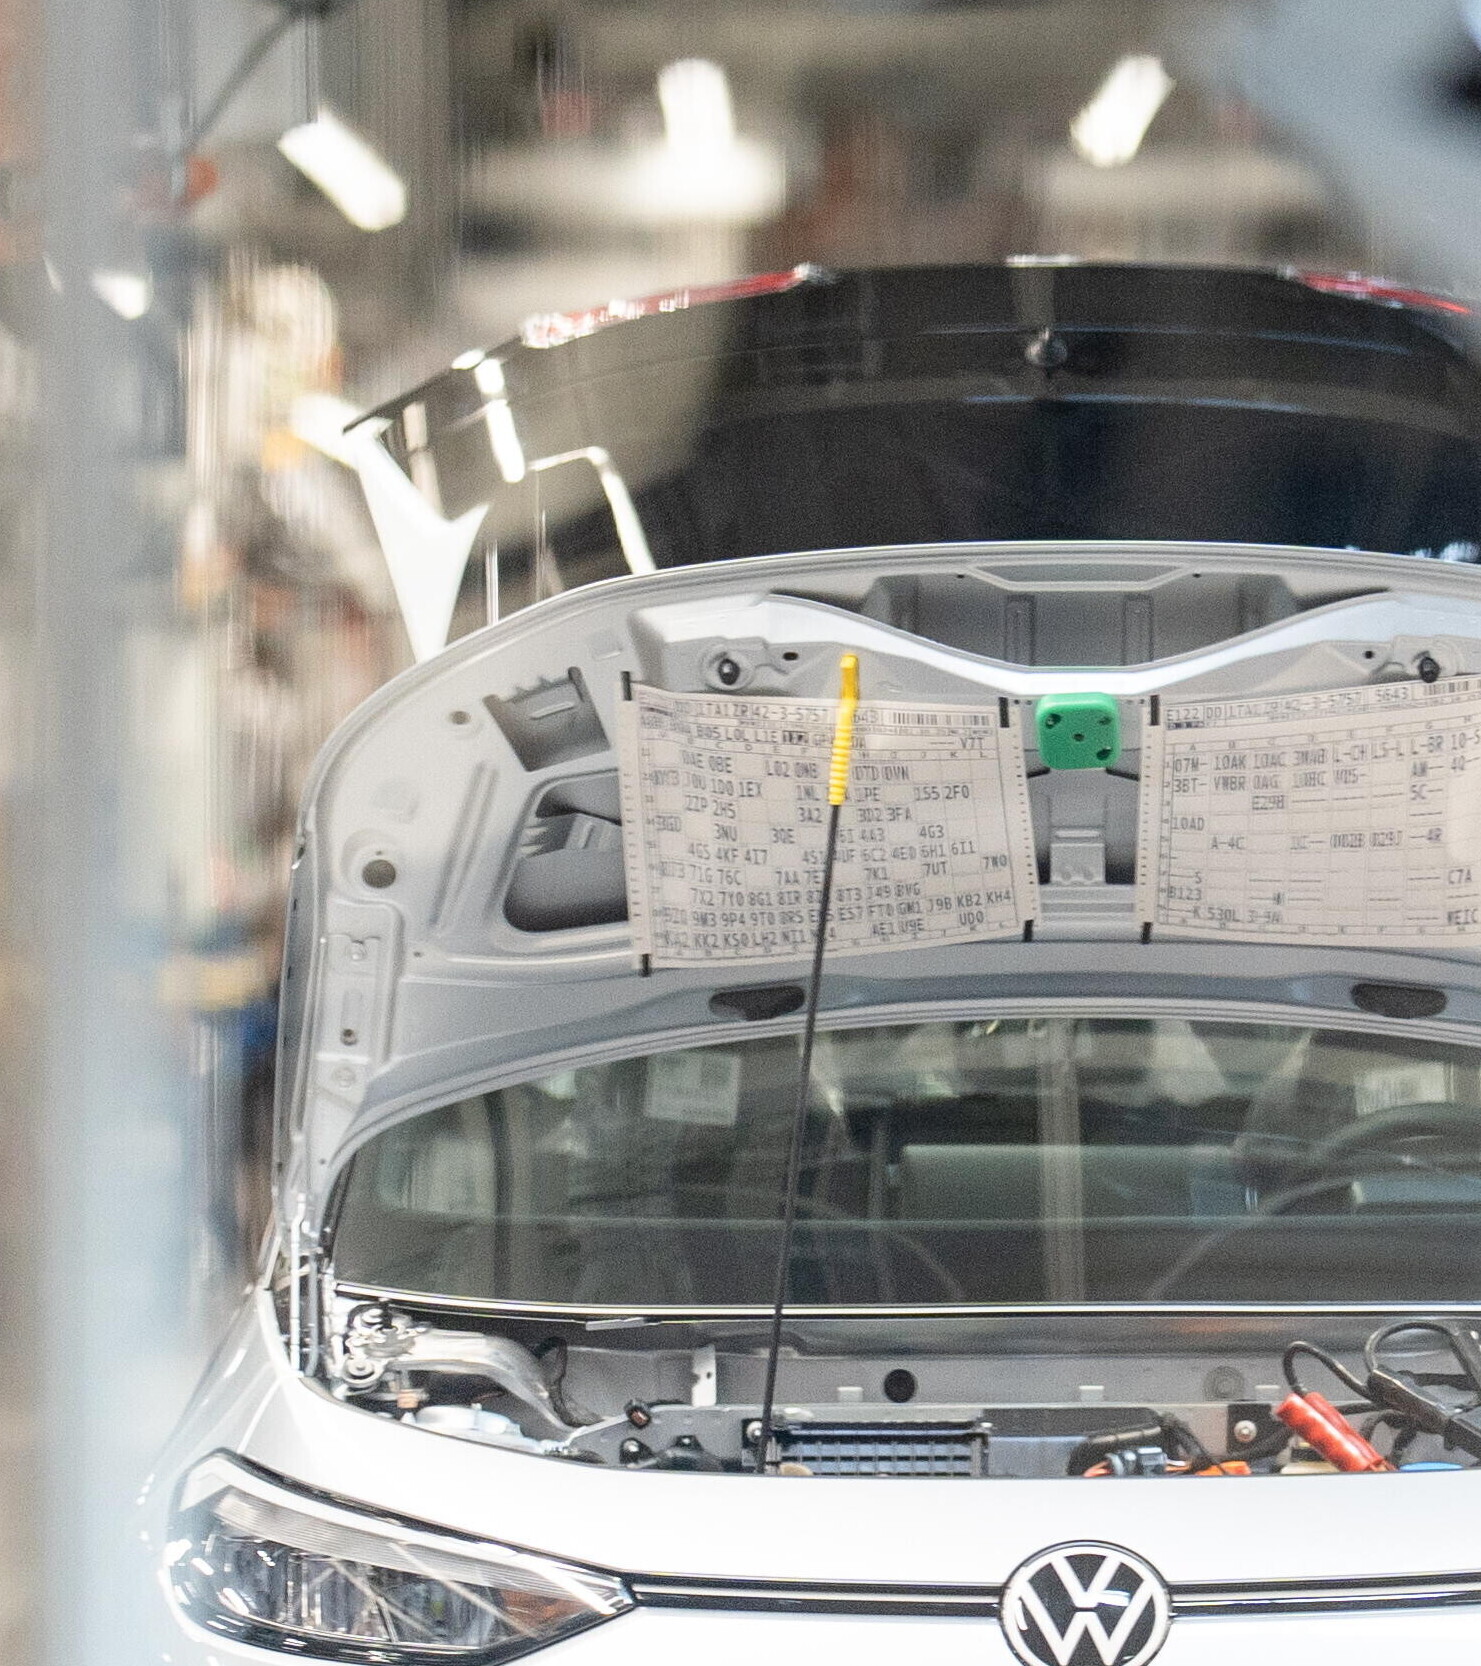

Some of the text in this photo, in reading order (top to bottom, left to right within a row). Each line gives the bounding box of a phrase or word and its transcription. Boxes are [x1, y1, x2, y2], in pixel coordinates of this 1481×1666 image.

[1167, 708, 1200, 722] E122
[1214, 755, 1246, 770] 10AK
[944, 785, 970, 799] 2F0
[1171, 817, 1204, 831] 10AD
[919, 825, 944, 839] 4G3
[957, 894, 982, 907] KB2
[986, 890, 1011, 905] KH4
[959, 911, 984, 926] UD0
